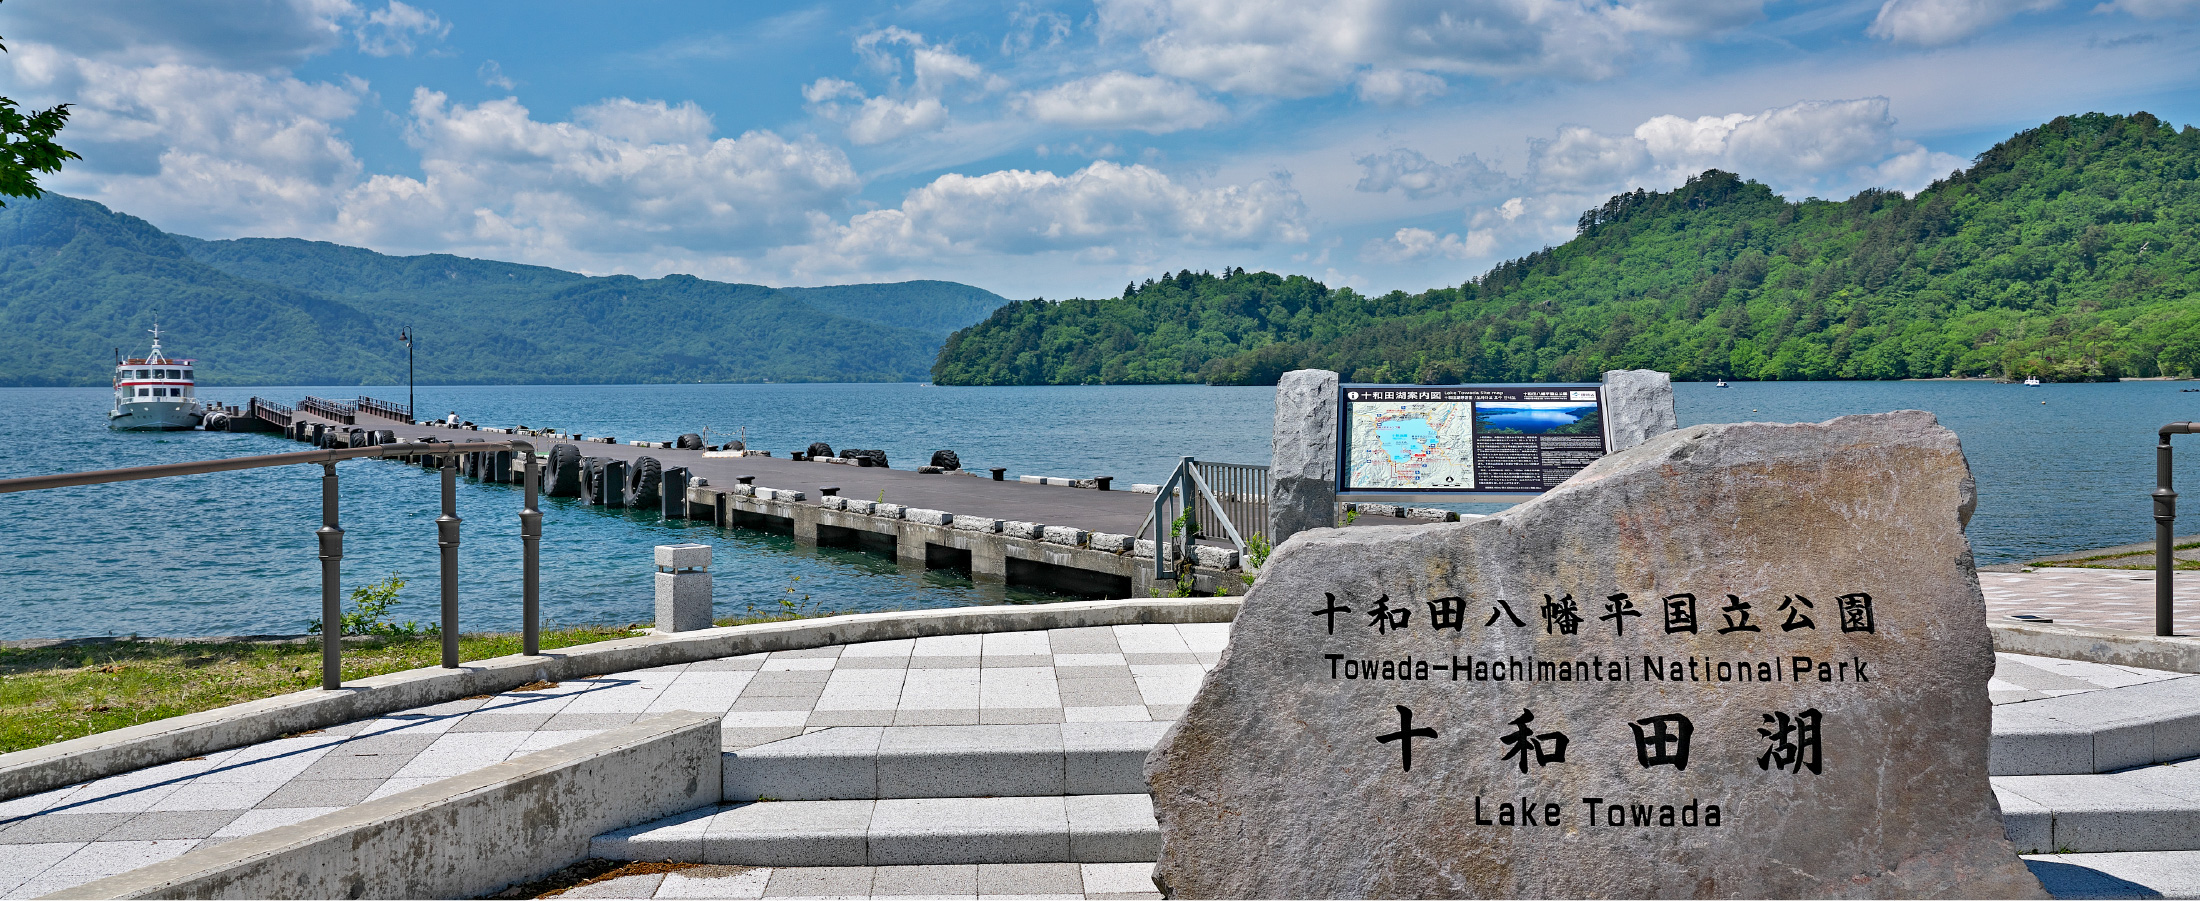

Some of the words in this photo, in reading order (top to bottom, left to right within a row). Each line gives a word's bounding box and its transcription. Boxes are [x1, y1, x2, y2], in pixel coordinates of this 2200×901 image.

[1361, 391, 1441, 400] 十和田湖案内図
[1311, 592, 1876, 637] 十和田八幡平国立公園
[1324, 653, 1631, 682] Towada-Hachimantai
[1643, 655, 1782, 682] National
[1791, 656, 1869, 683] Park
[1375, 704, 1824, 776] 十和田湖
[1475, 796, 1561, 827] Lake
[1582, 797, 1721, 828] Towada
